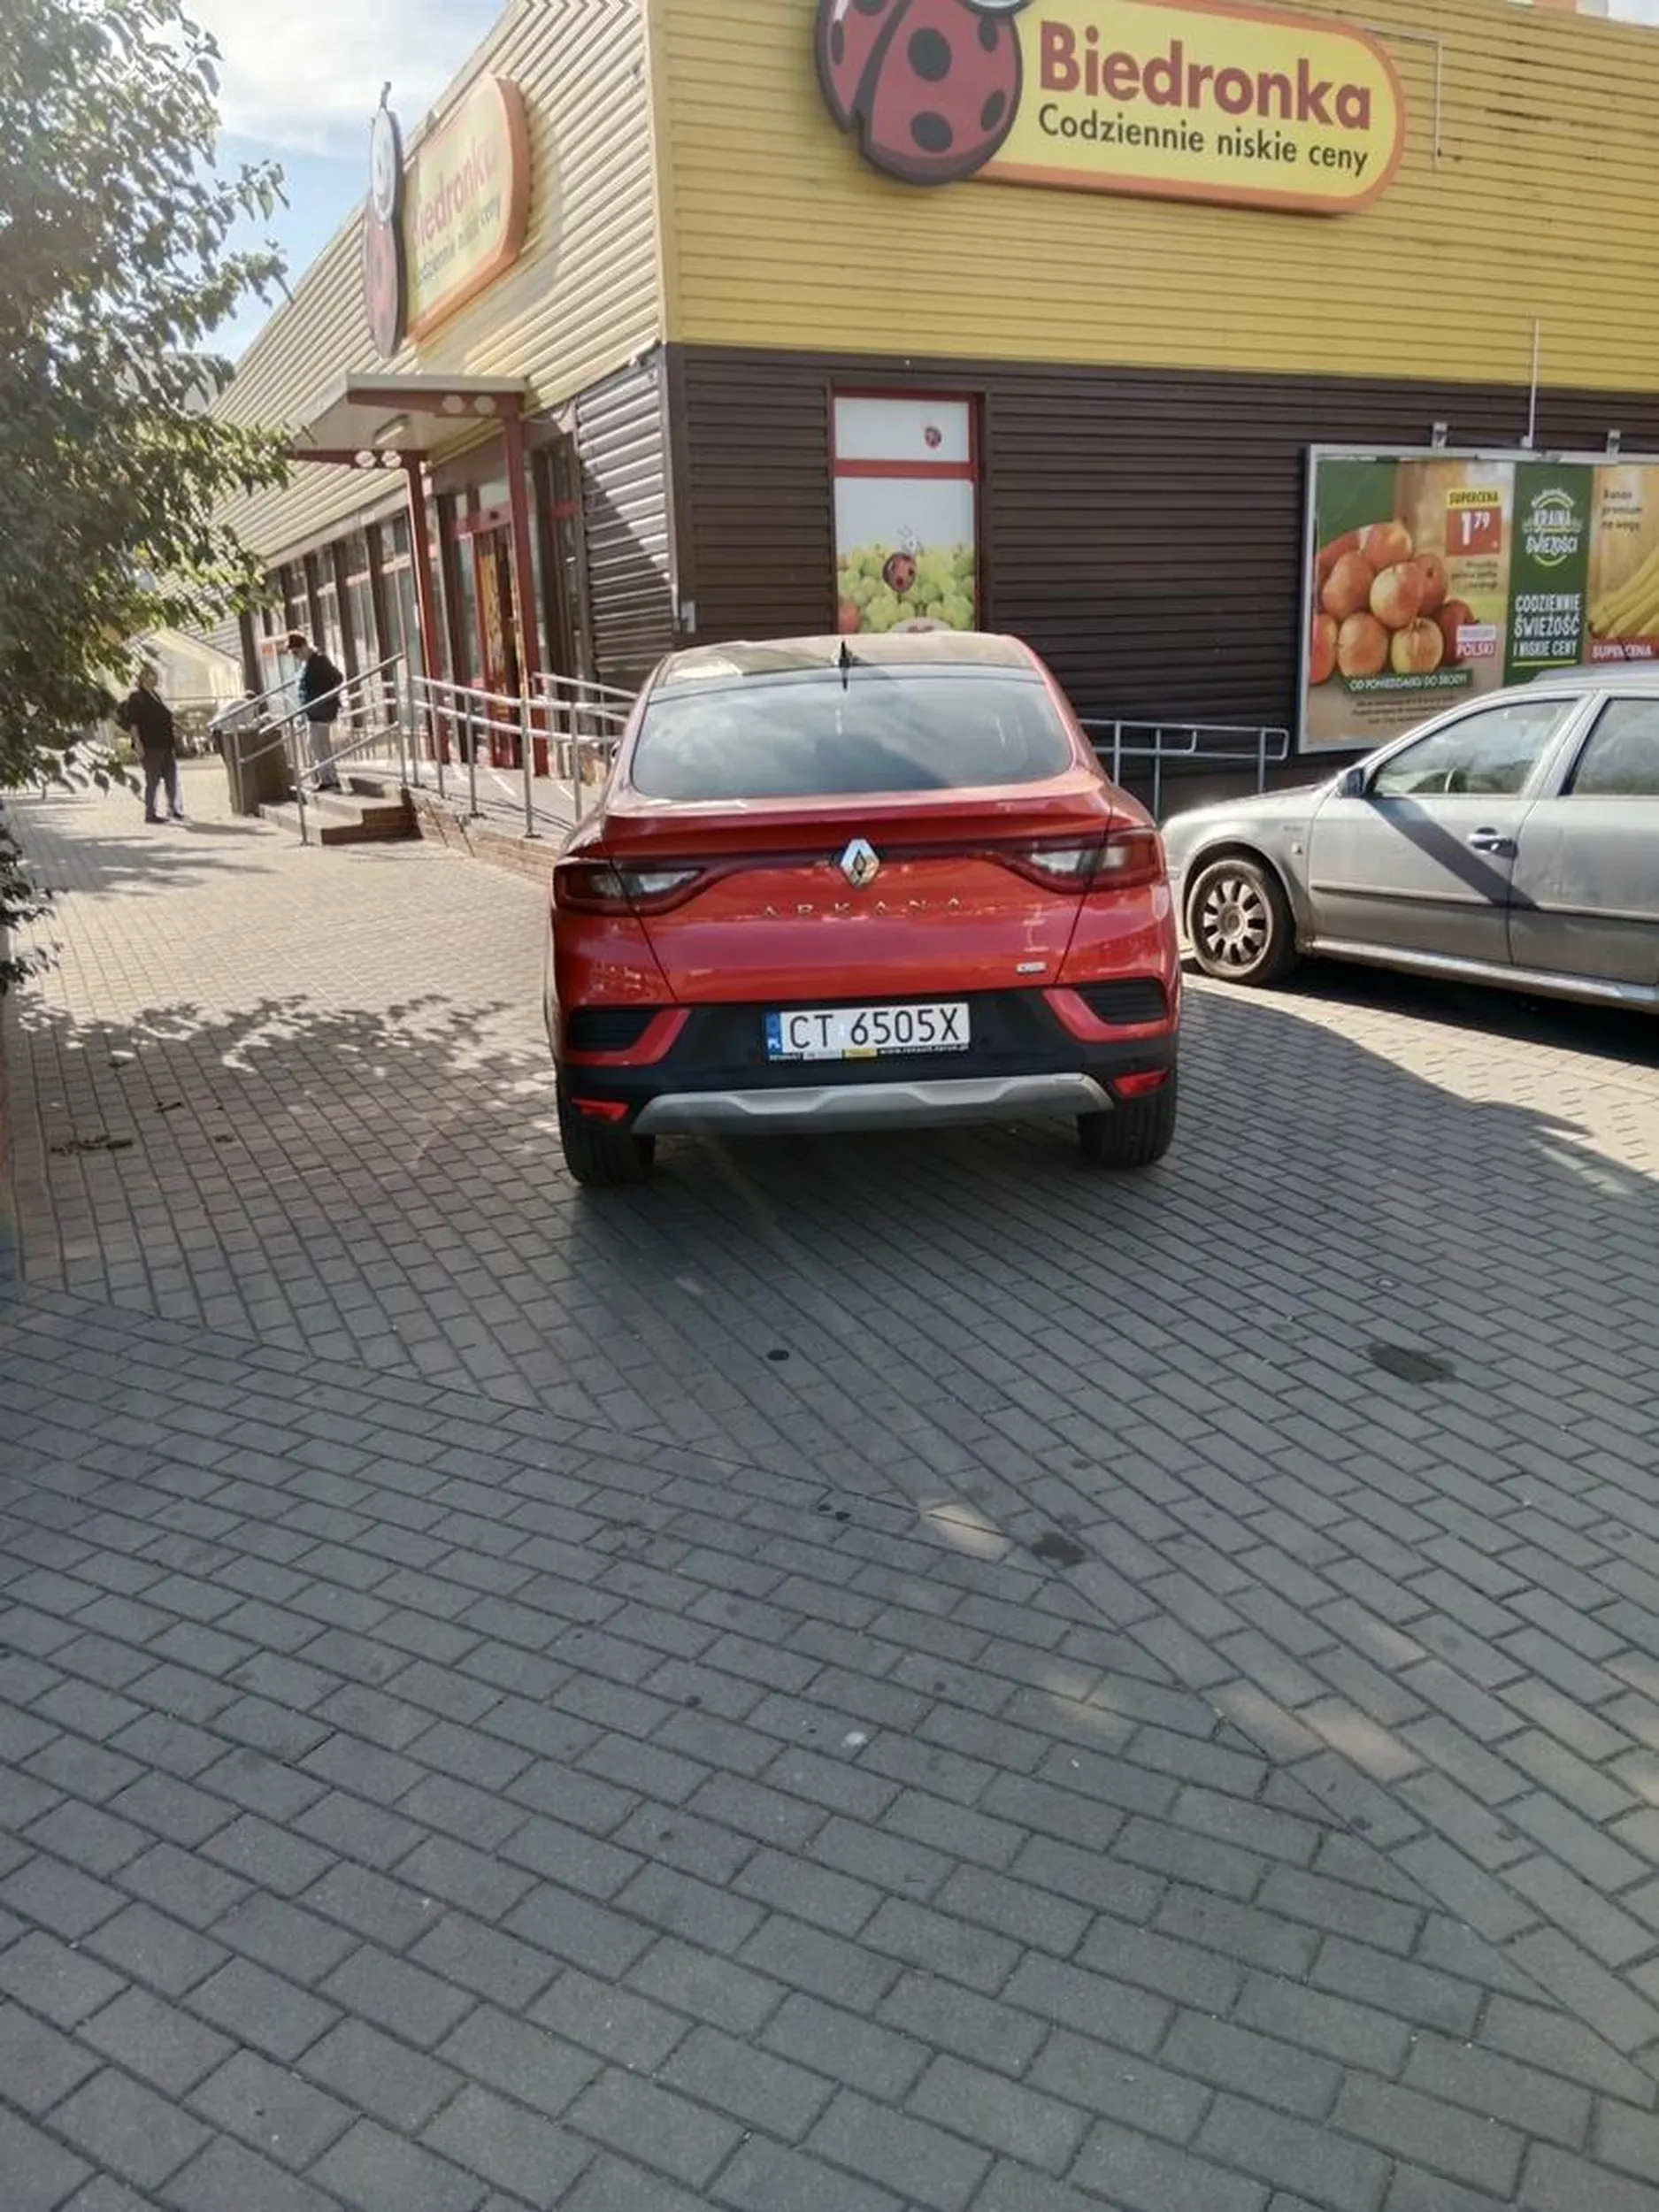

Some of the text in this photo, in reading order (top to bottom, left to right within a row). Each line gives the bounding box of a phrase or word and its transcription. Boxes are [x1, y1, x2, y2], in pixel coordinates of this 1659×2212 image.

[1041, 20, 1371, 131] Biedronka
[1039, 104, 1369, 177] Codziennie niskie ceny
[1515, 594, 1582, 612] CODZIENNIE
[1552, 640, 1578, 657] CENY
[789, 1009, 961, 1049] CT 6505X
